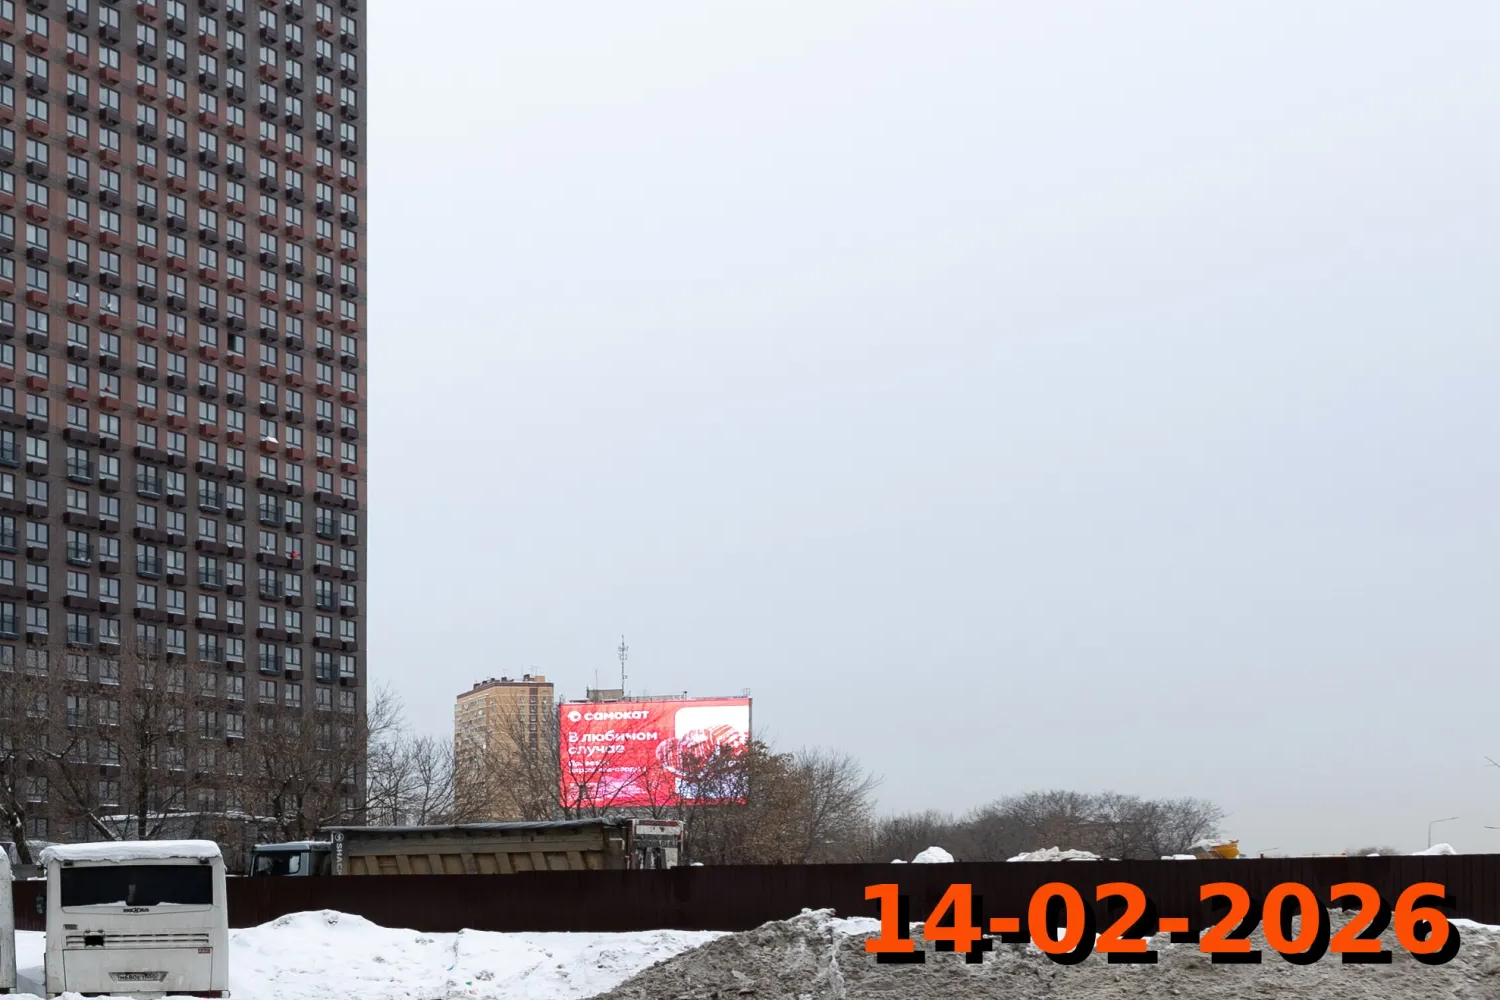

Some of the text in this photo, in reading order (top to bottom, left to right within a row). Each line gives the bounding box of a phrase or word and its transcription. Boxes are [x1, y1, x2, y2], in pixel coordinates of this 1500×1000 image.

[584, 710, 649, 721] самокат
[568, 729, 658, 742] В любимом
[568, 744, 625, 757] случае
